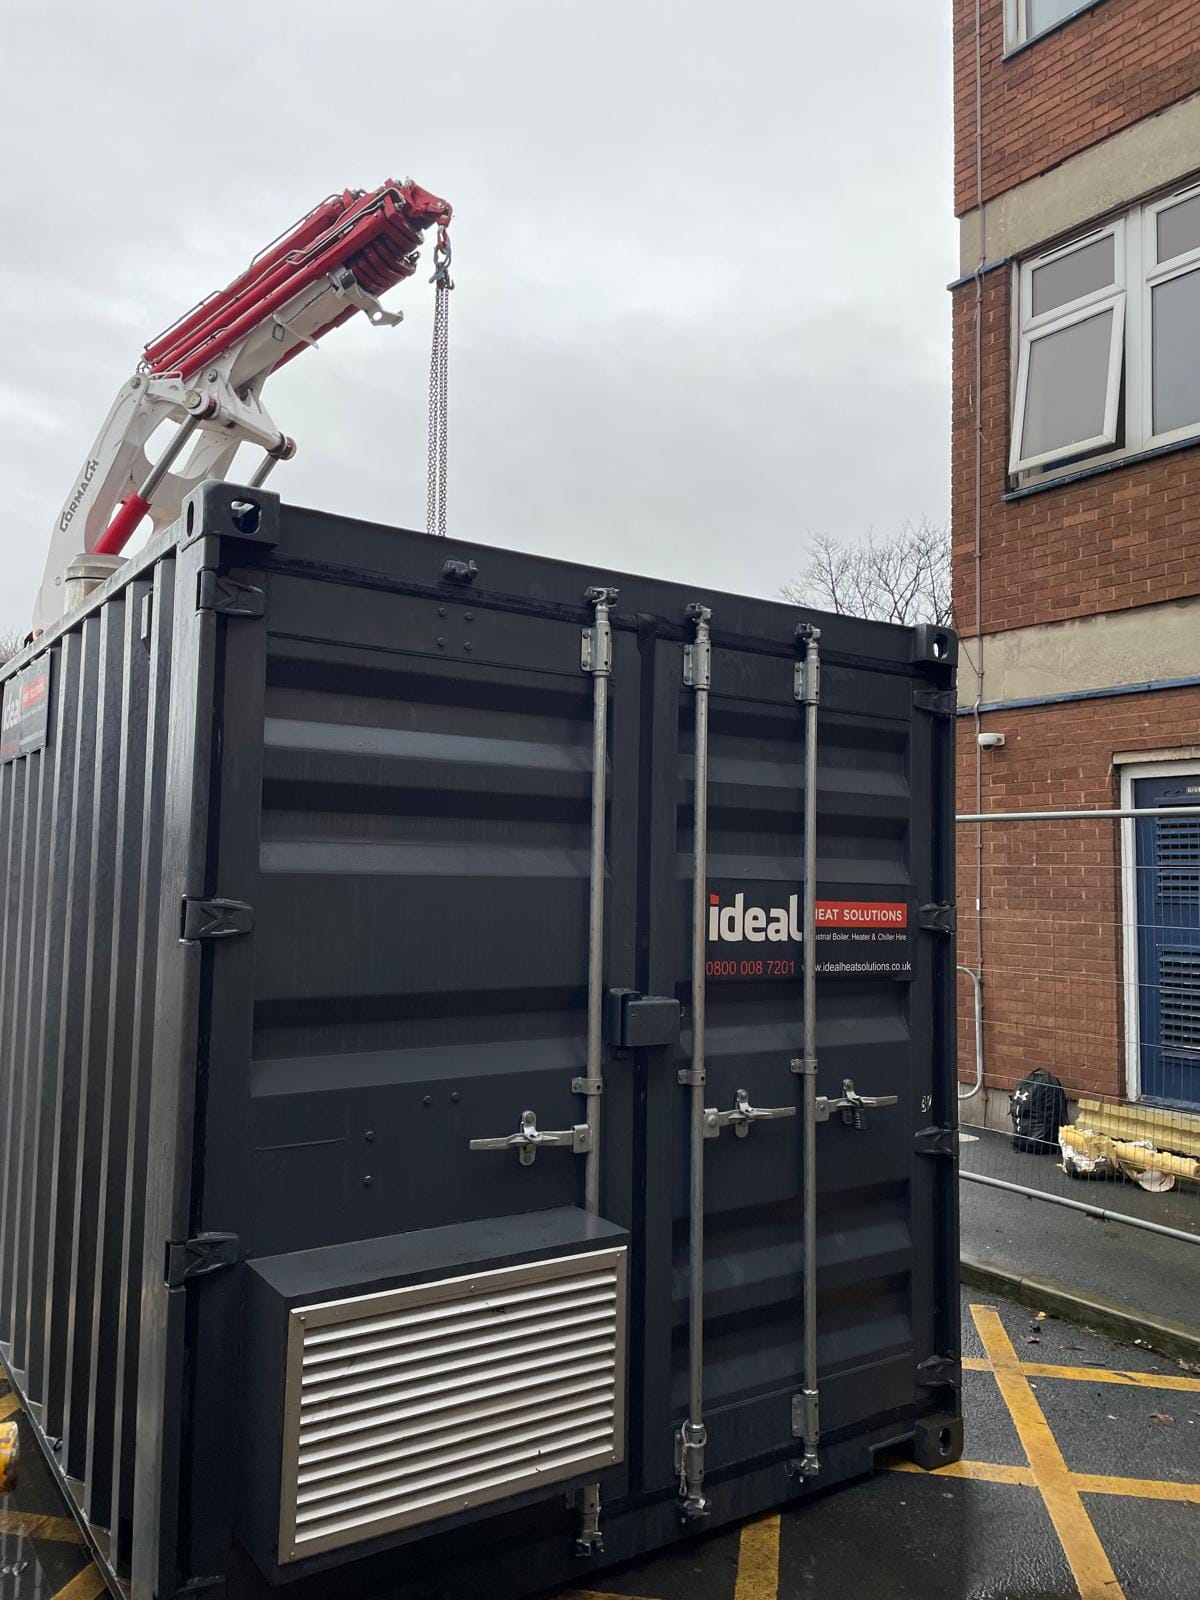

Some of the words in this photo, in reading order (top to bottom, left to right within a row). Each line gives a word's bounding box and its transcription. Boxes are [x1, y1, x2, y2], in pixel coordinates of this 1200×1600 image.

[60, 460, 99, 533] CORMACH
[709, 893, 803, 942] ideal
[815, 909, 840, 921] EAT
[843, 909, 903, 922] SOLUTIONS
[851, 932, 871, 941] Heater
[871, 933, 876, 941] &
[895, 933, 907, 941] Hire
[706, 960, 737, 976] 0800
[740, 960, 764, 976] 008
[767, 960, 795, 976] 7201
[802, 961, 912, 973] w.idealheatsolutions.co.uk
